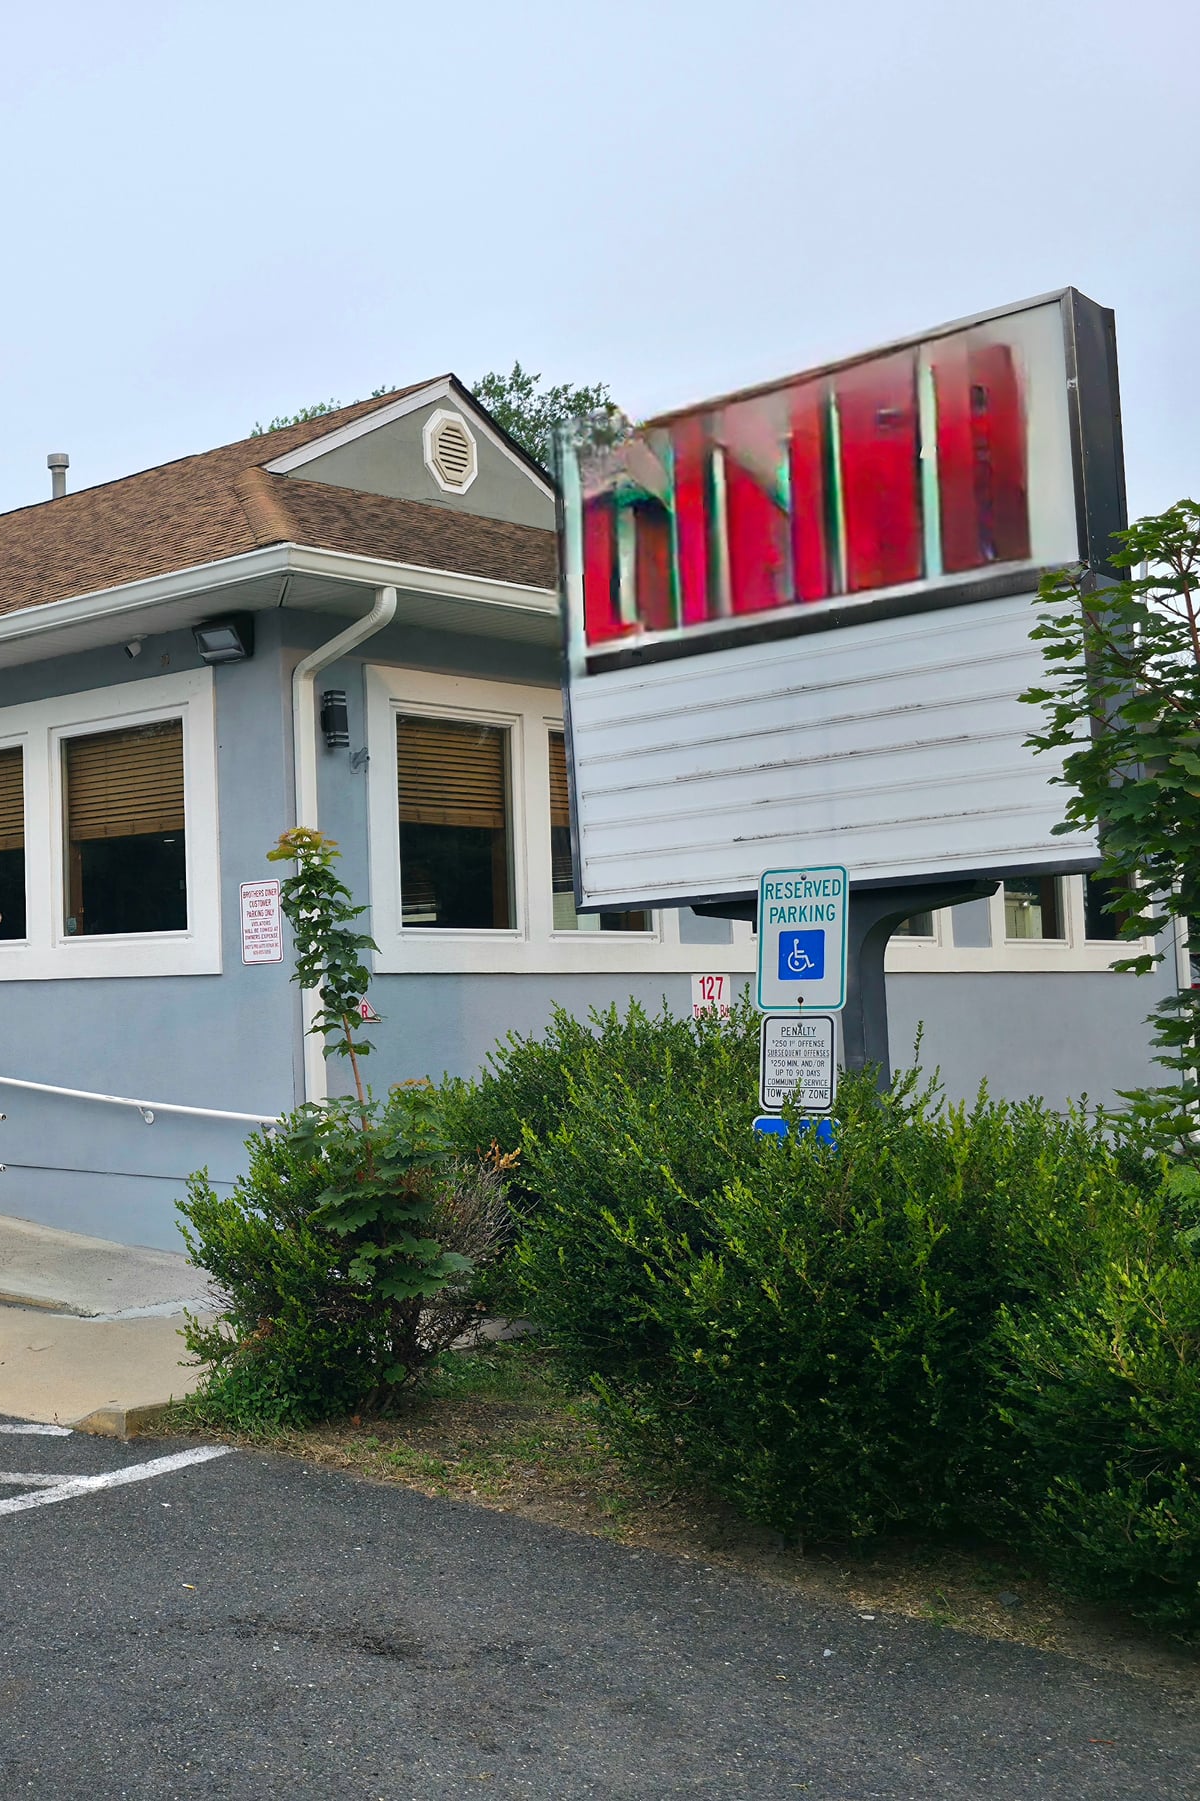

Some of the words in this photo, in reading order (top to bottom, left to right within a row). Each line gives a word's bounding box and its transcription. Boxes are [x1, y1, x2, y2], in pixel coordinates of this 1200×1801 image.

[765, 879, 841, 900] RESERVED
[770, 904, 835, 924] PARKING
[699, 976, 724, 1000] 127
[361, 1004, 368, 1018] R
[781, 1026, 816, 1036] PENALTY
[768, 1049, 801, 1057] SUBSEQUENT
[767, 1088, 805, 1098] TOW-AWY
[809, 1090, 828, 1099] ZONE
